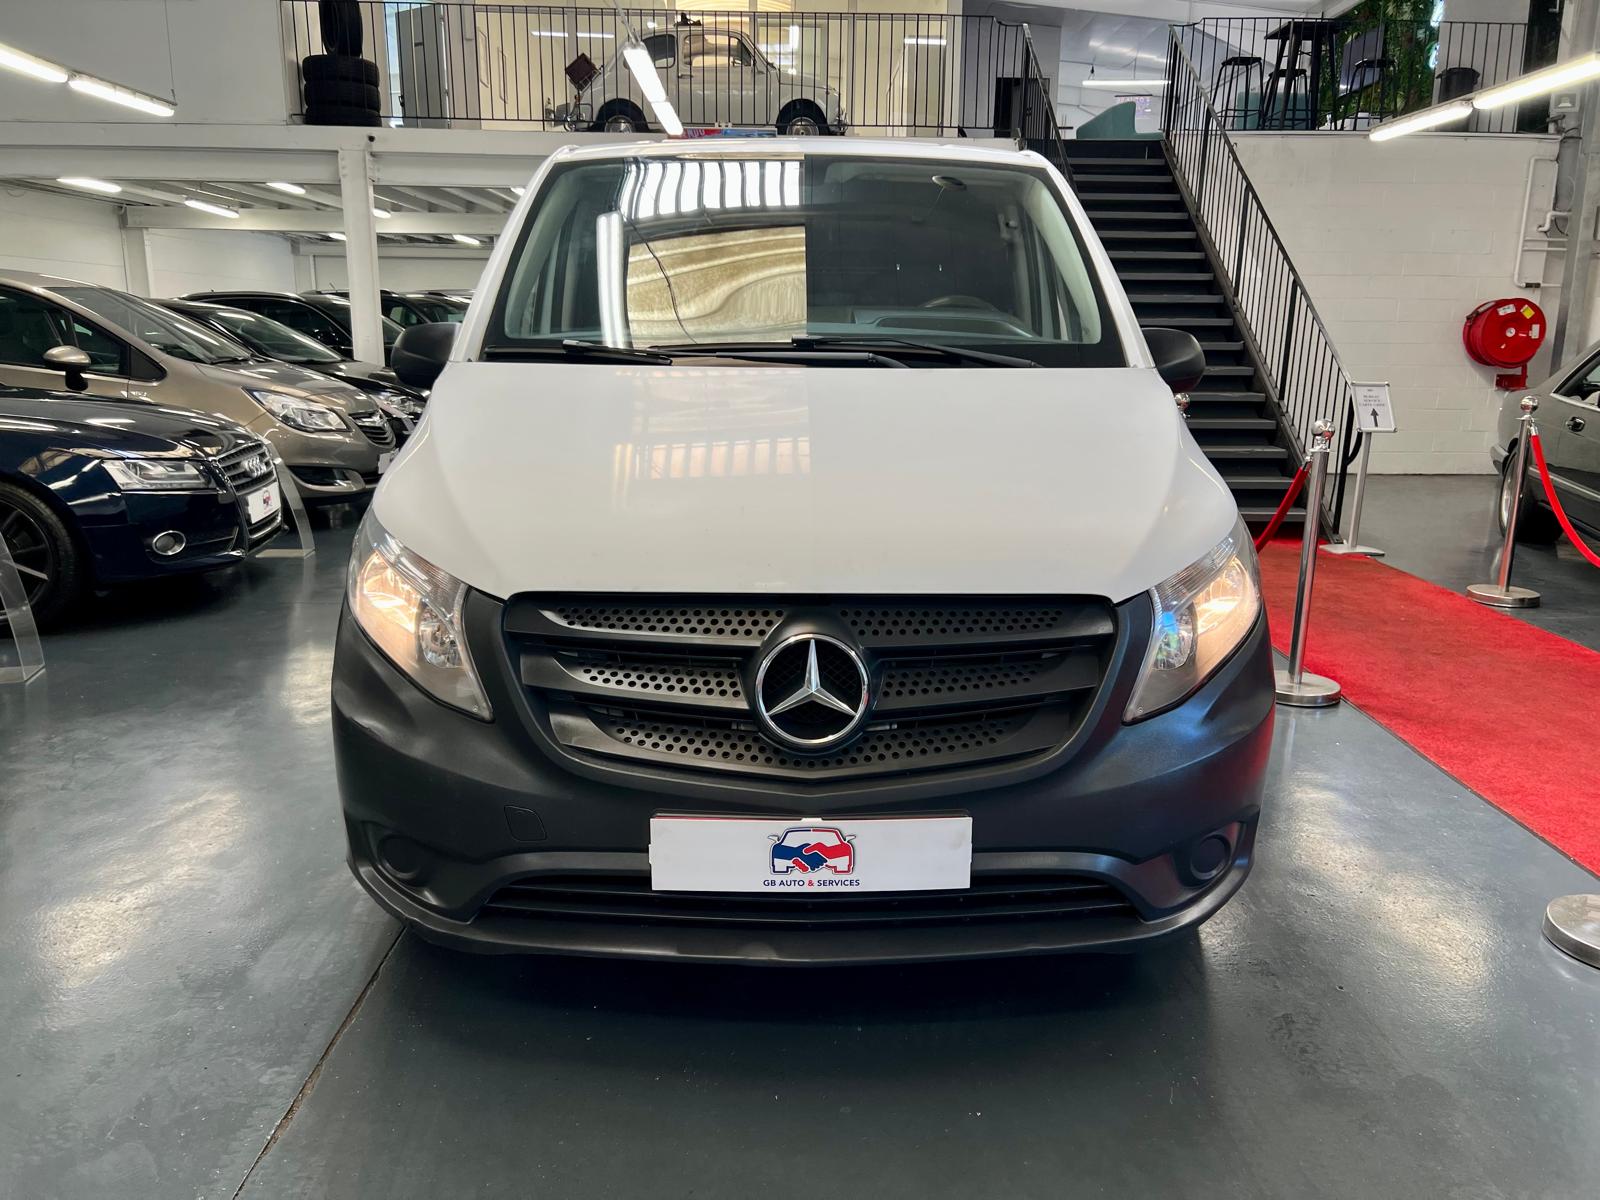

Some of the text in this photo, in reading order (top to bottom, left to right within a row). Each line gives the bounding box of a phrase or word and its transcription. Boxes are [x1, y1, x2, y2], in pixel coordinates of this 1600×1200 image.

[763, 879, 860, 887] GB AUTO & SERVICES
